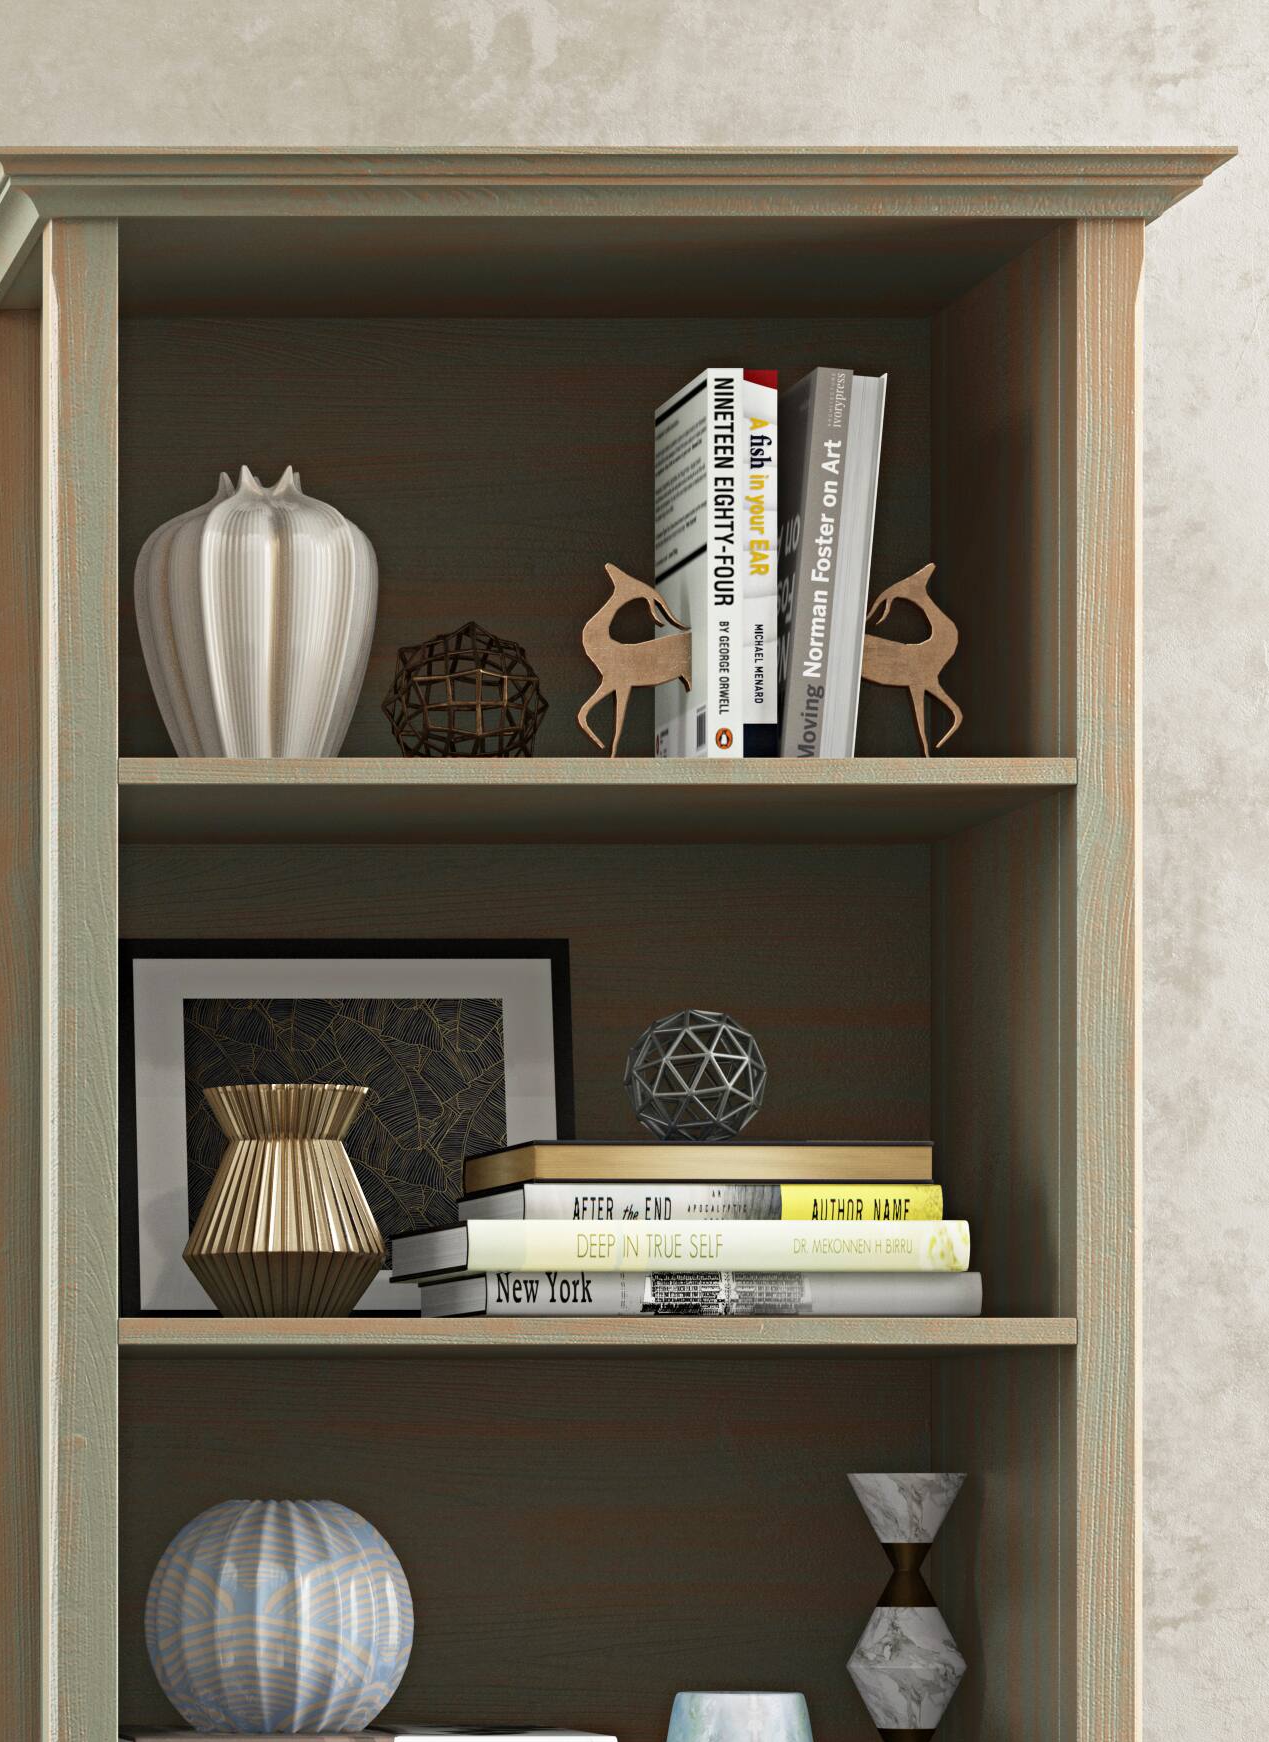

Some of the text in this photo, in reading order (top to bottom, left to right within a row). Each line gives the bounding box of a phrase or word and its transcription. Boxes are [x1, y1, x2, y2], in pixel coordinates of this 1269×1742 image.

[821, 439, 842, 474] Art
[714, 378, 734, 606] NINETEEN EIGHTY-FOUR
[744, 417, 772, 575] A fish in your EAR
[823, 481, 838, 508] on
[811, 513, 835, 582] Foster
[803, 590, 828, 678] Norman
[719, 621, 730, 715] BY GEORGE ORWELL
[754, 624, 764, 704] MICHAEL MENARD
[573, 1197, 672, 1220] AFTER the END
[812, 1199, 910, 1220] AUTHOR NAME
[577, 1234, 723, 1258] DEEP IN TRUE SELF
[812, 1239, 871, 1254] MEKONNEN
[886, 1239, 913, 1254] BIRRU
[496, 1272, 539, 1303] New
[545, 1272, 593, 1303] York
